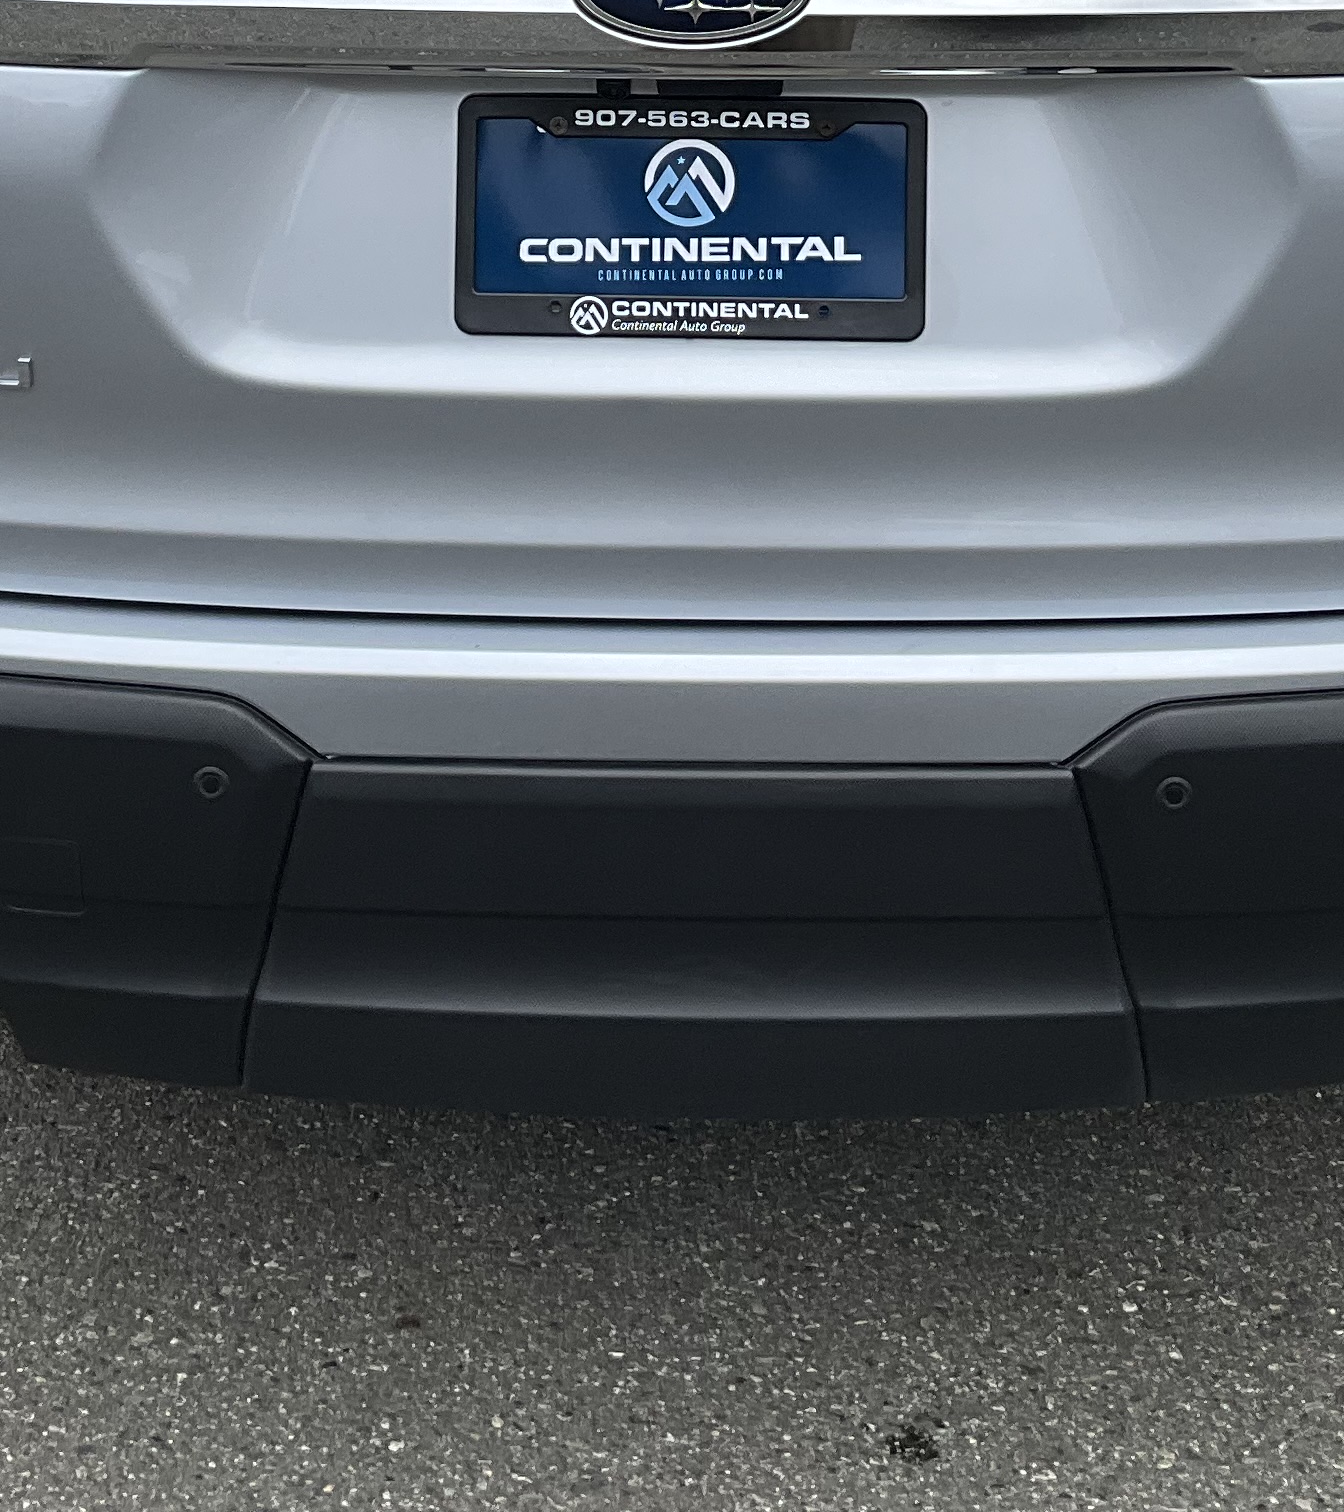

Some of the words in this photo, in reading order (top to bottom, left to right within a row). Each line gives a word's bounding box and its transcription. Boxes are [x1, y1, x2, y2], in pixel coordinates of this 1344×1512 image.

[574, 109, 811, 130] 907-563-CARS
[519, 236, 862, 263] CONTINENTAL
[598, 268, 677, 281] CONTINENTAL
[680, 268, 710, 281] AUTO
[611, 300, 809, 319] CONTINENTAL
[611, 319, 677, 331] Continental
[679, 320, 708, 332] Auto
[710, 320, 746, 336] Group
